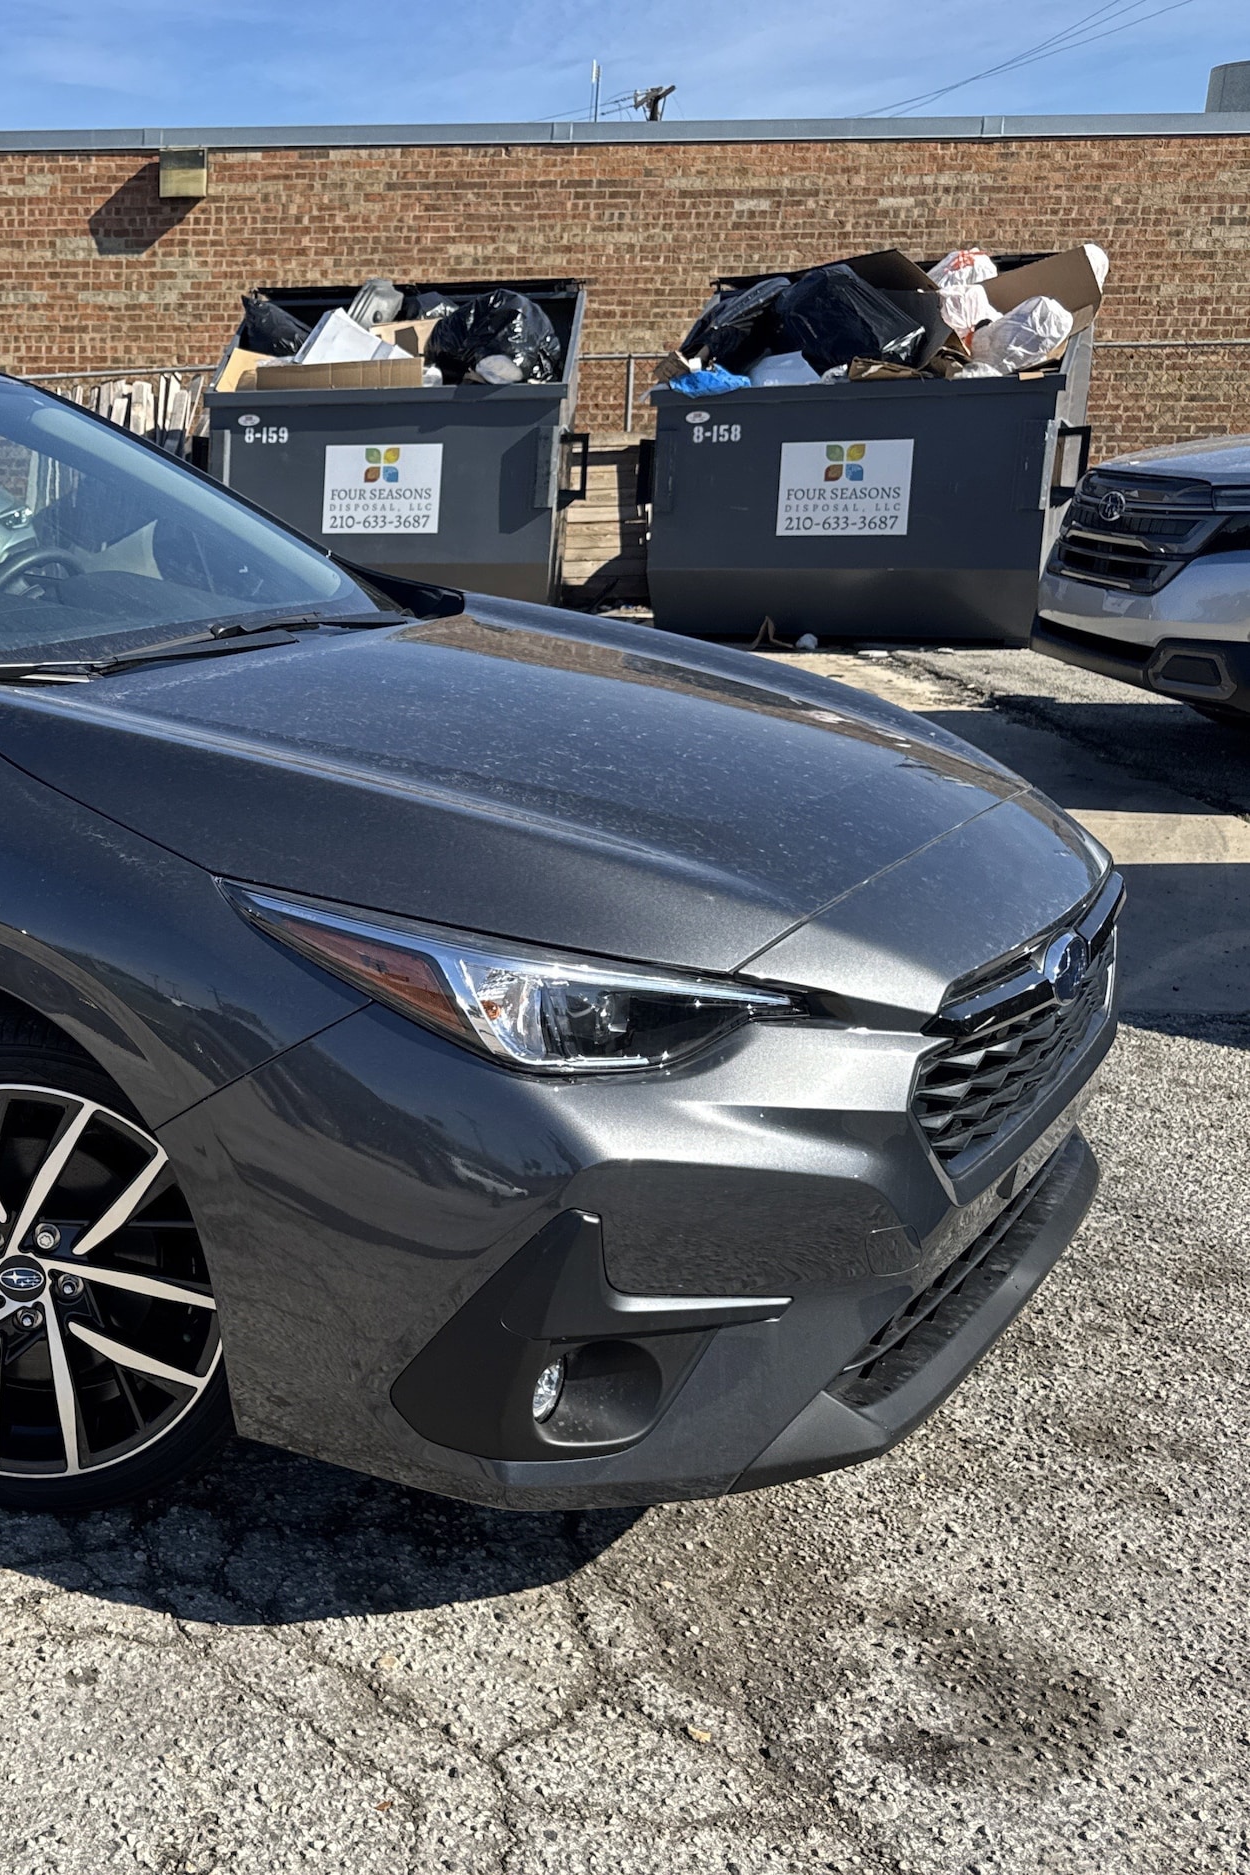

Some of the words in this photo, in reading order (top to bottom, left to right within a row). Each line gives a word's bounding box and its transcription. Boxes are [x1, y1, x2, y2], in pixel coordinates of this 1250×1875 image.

[244, 426, 289, 444] 8-159
[692, 424, 741, 443] 8-158
[330, 488, 366, 500] FOUR
[369, 487, 432, 500] SEASONS
[786, 487, 826, 501] FOUR
[830, 486, 902, 500] SEASONS
[329, 503, 401, 512] DISPOSAL,
[409, 503, 433, 512] LLC
[784, 503, 866, 513] DISPOSAL,
[875, 502, 902, 512] LLC
[329, 514, 430, 529] 210-633-3687
[784, 515, 899, 531] 210-633-3687
